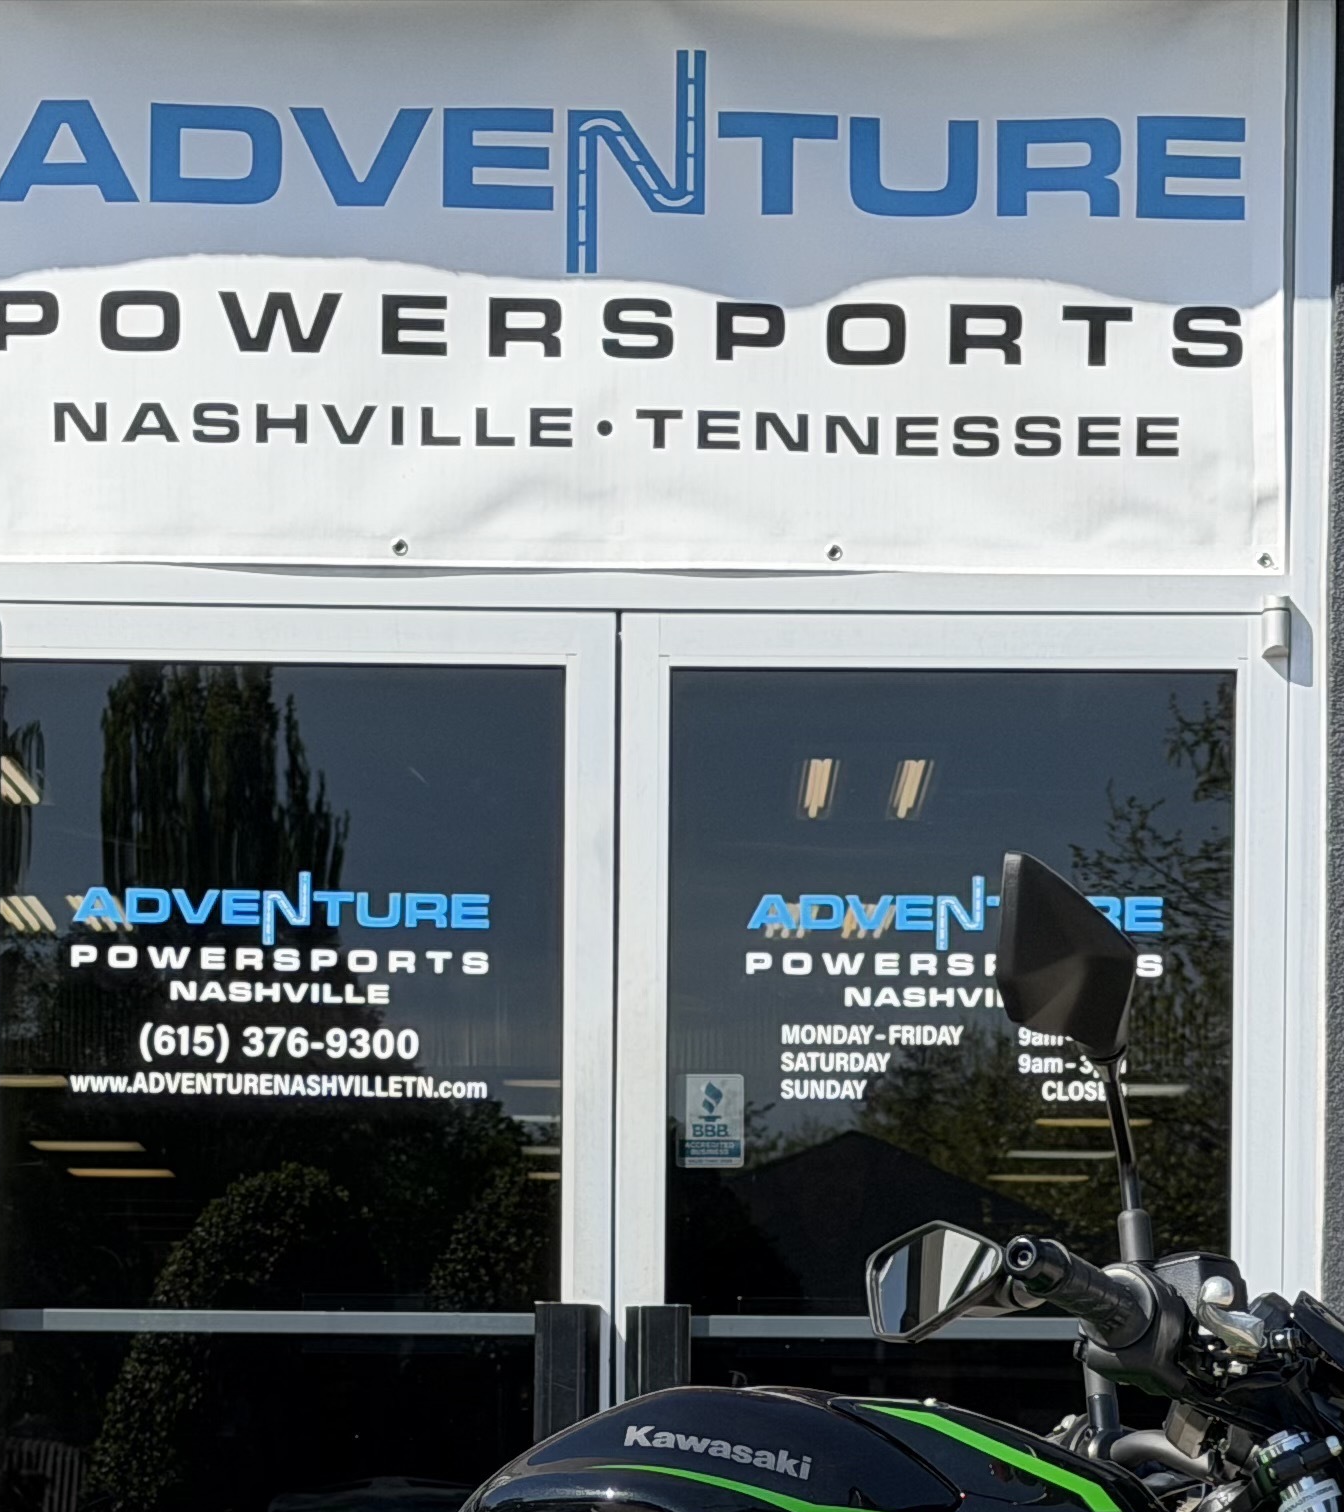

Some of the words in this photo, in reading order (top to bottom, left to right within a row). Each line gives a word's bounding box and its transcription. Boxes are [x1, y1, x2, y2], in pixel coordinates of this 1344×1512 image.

[53, 401, 574, 449] NASHVILLE
[635, 407, 1181, 458] TENNESSEE
[72, 871, 492, 946] ADVENTURE
[69, 944, 490, 975] POWERSPORTS
[169, 980, 391, 1006] NASHVILLE
[139, 1021, 230, 1064] (615)
[242, 1026, 421, 1061] 376-9300
[780, 1051, 892, 1073] SATURDAY
[69, 1070, 489, 1100] www.ADVENTURENASHVILLETN.com
[780, 1078, 868, 1101] SUNDAY
[692, 1123, 729, 1138] BBB
[622, 1424, 814, 1481] Kawasaki
